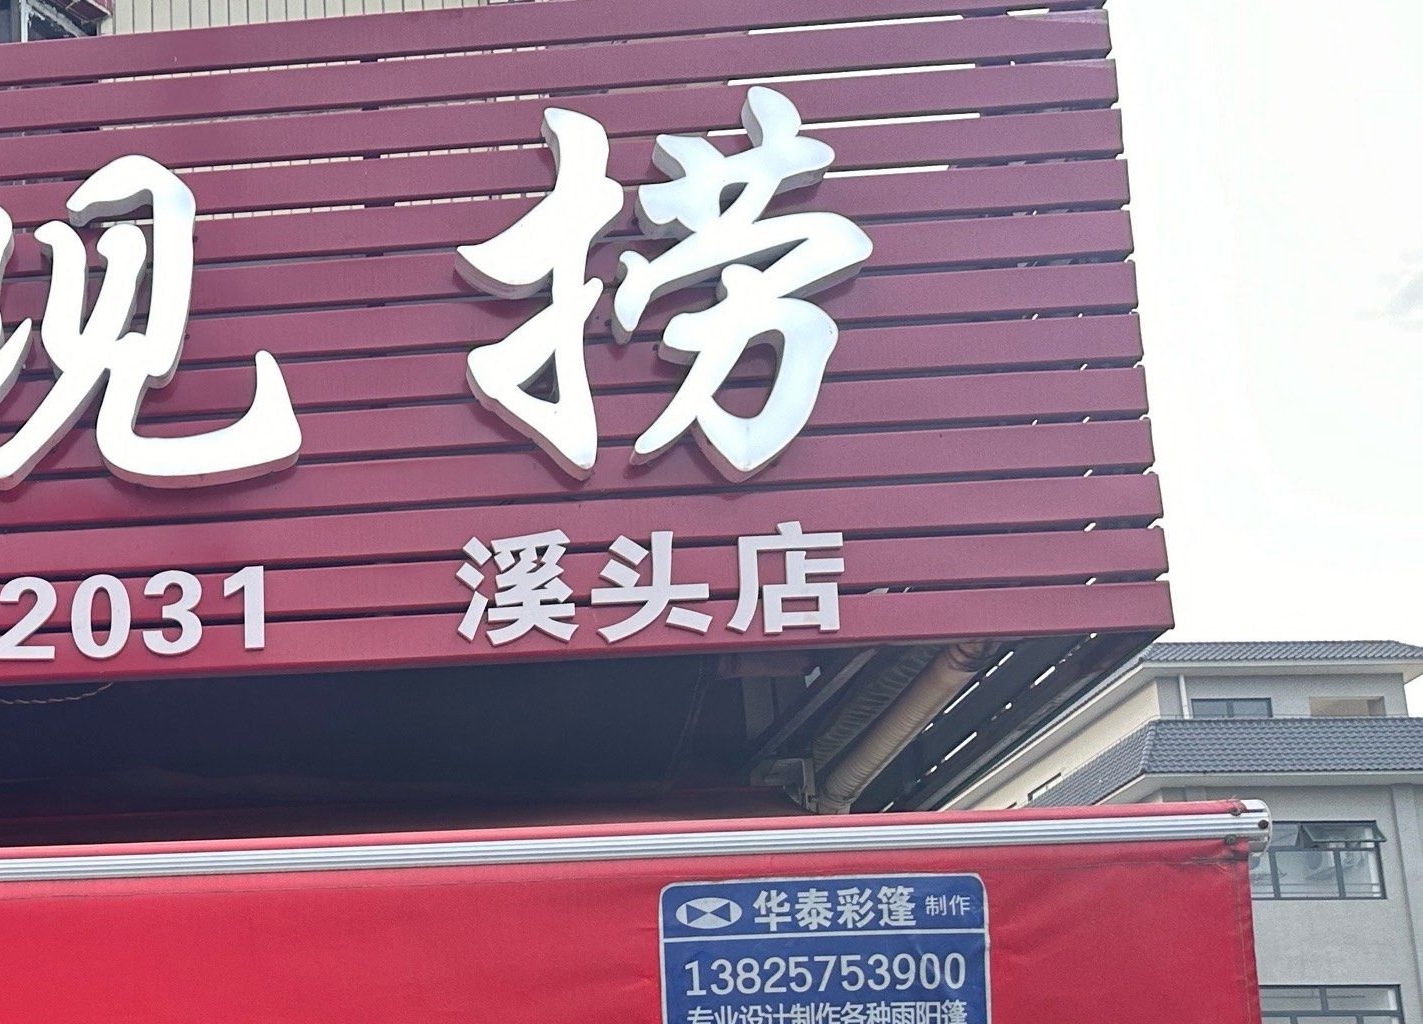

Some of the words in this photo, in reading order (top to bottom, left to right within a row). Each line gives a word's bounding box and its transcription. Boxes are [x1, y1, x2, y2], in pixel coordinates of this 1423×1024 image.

[454, 521, 846, 645] 溪头店
[752, 884, 917, 932] 华泰彩篷
[924, 894, 972, 917] 制作
[684, 952, 967, 997] 13825753900
